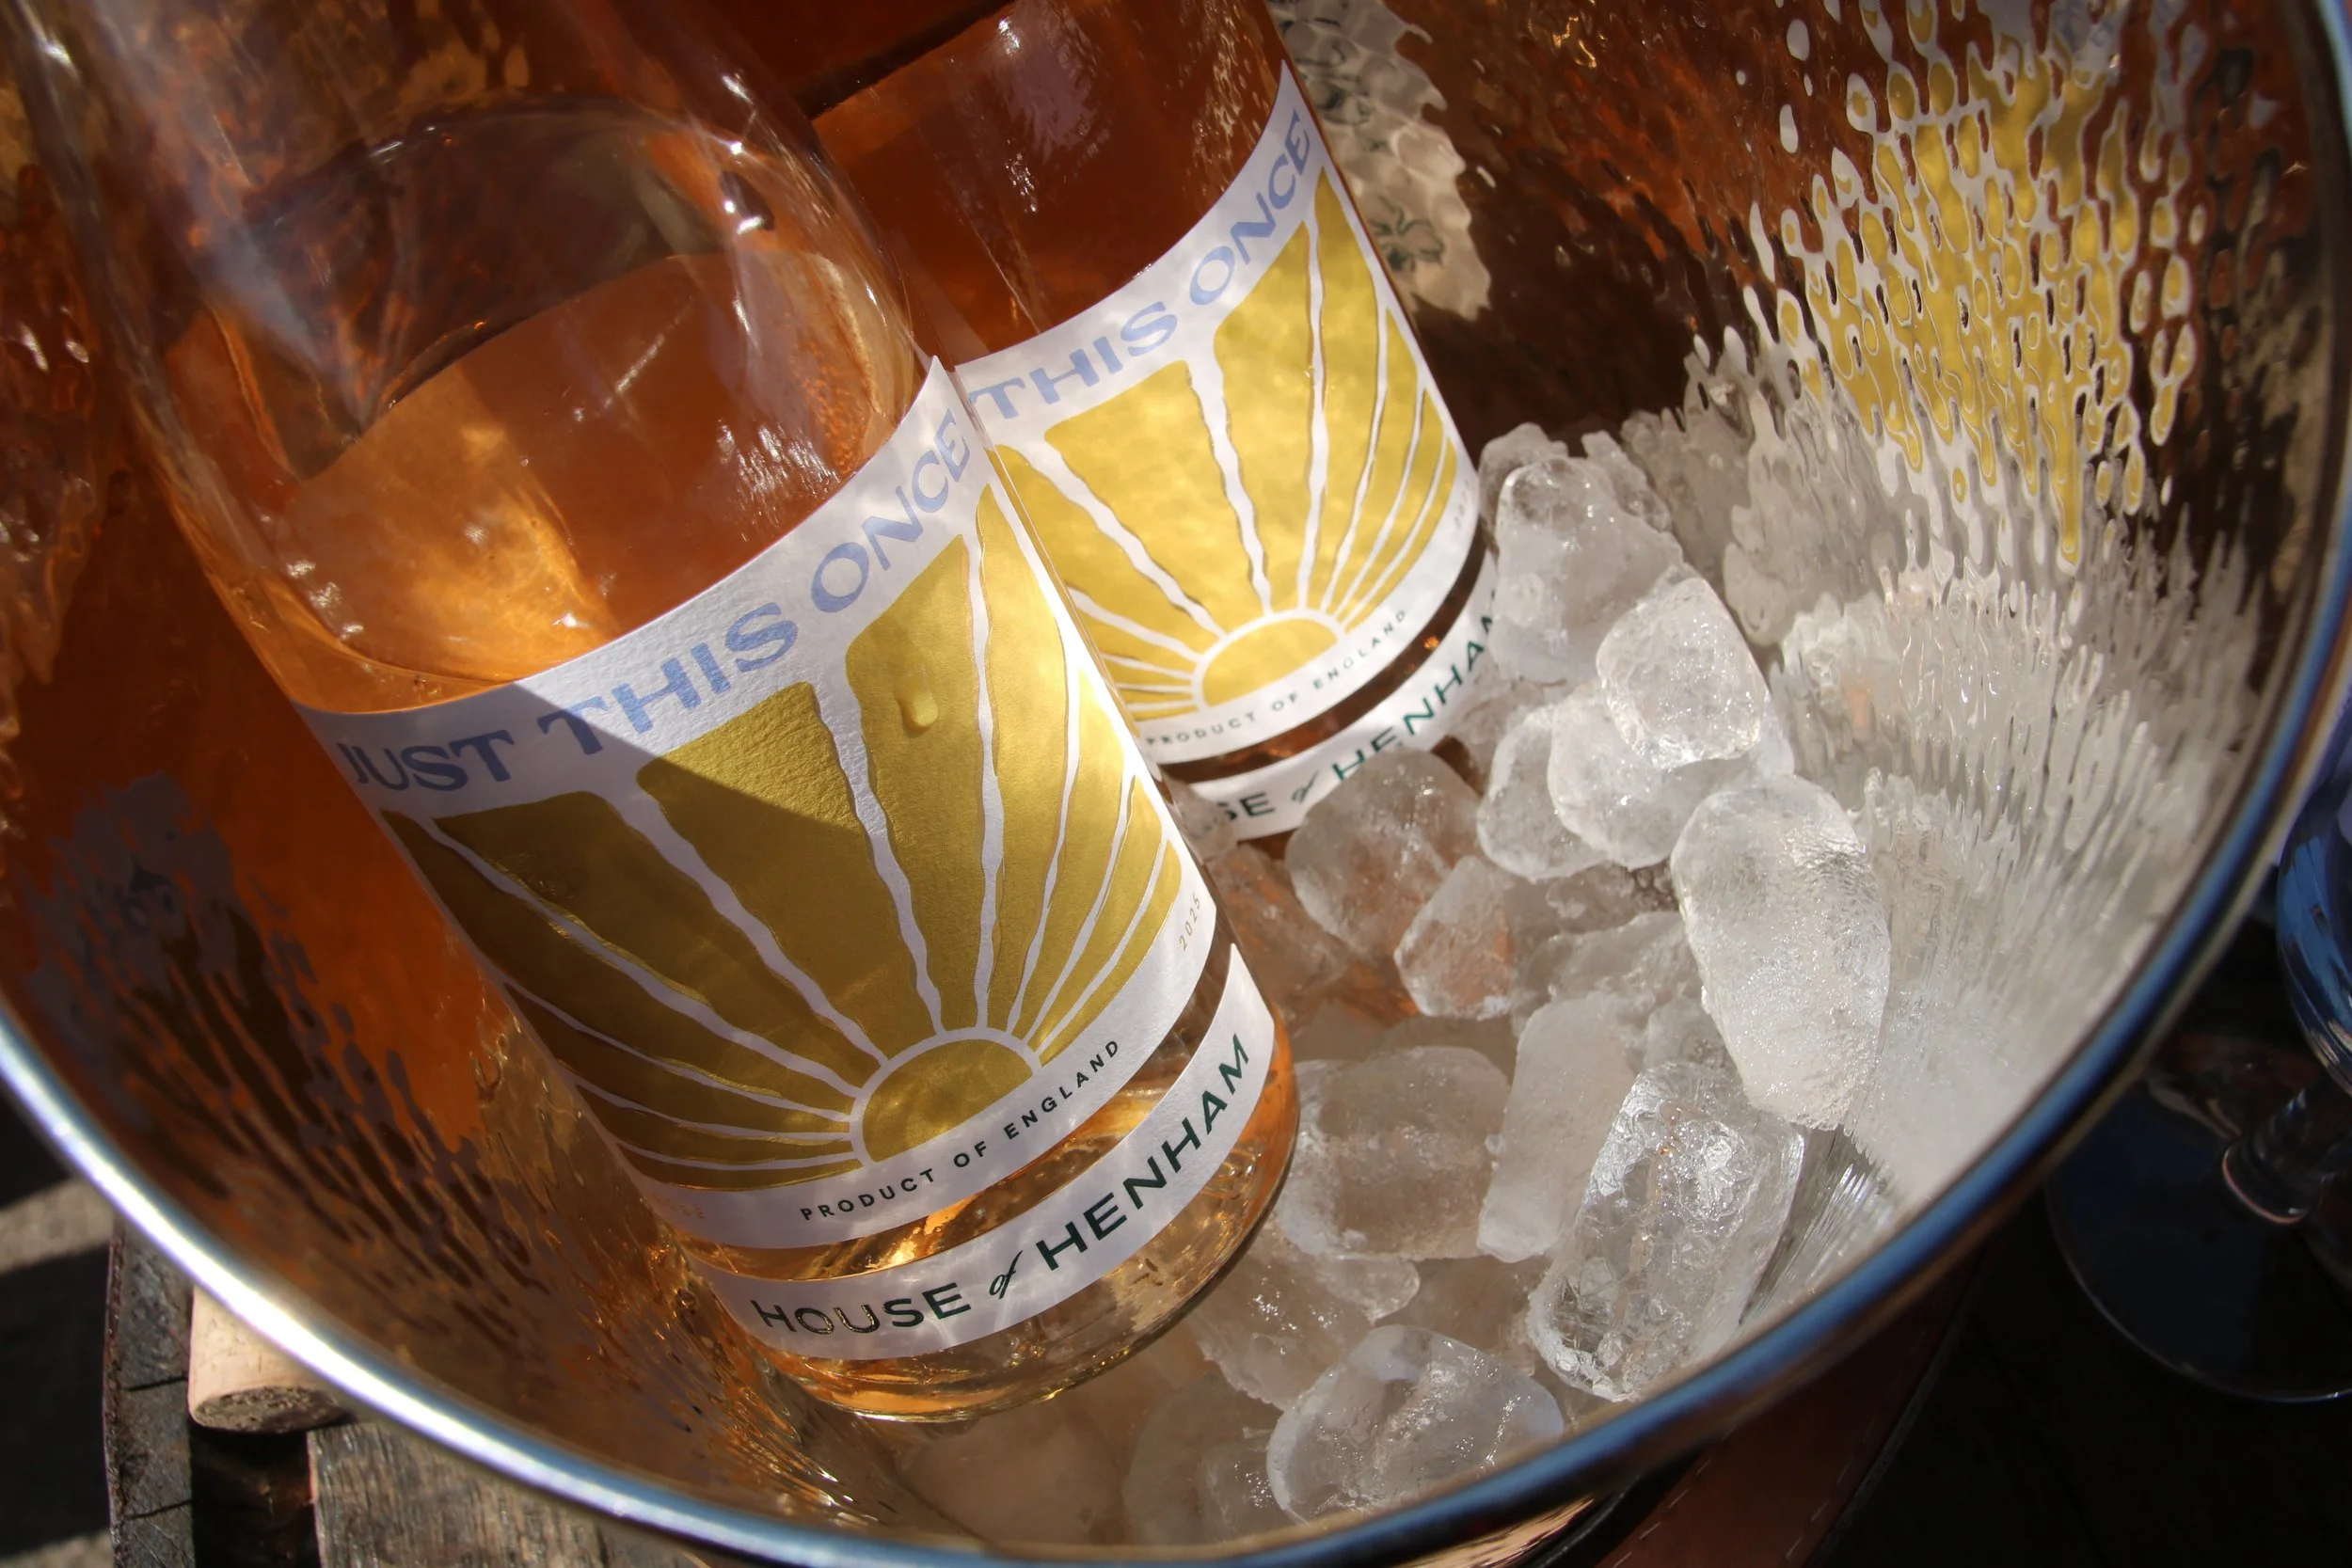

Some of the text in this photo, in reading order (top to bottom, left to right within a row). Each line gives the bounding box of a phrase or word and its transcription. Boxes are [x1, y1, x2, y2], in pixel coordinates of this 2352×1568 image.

[969, 110, 1311, 420] THIS ONCE
[337, 409, 970, 792] JUST THIS ONCE
[1146, 610, 1406, 746] PRODUCT OF ENGLAND
[1179, 892, 1201, 952] 2025
[751, 1034, 1250, 1336] HOUSE of HENHAM
[800, 1040, 1120, 1221] PRODUCT OF ENGLAND
